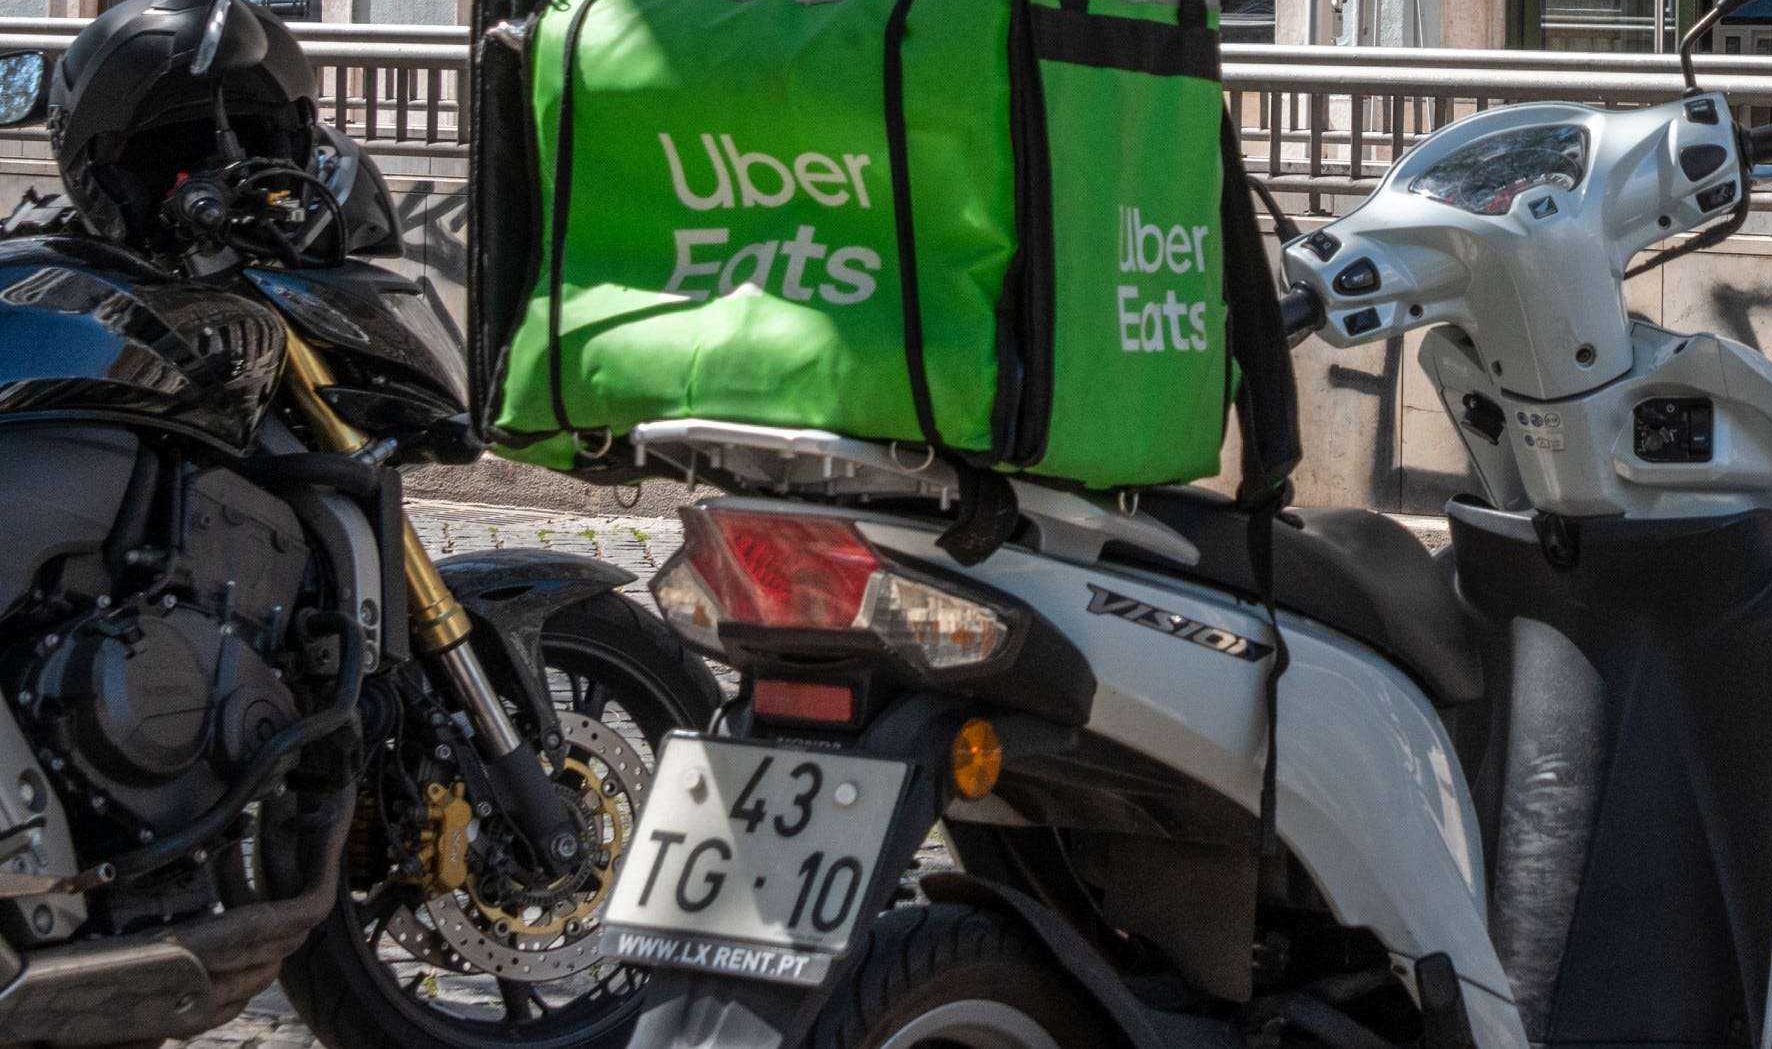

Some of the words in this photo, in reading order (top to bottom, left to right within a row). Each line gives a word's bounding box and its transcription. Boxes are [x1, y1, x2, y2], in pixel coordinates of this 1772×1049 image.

[657, 132, 872, 211] Uber
[664, 224, 882, 305] Eats
[1118, 204, 1209, 274] Uber
[1117, 285, 1208, 353] Eats
[729, 756, 824, 838] 43
[638, 828, 732, 913] TG
